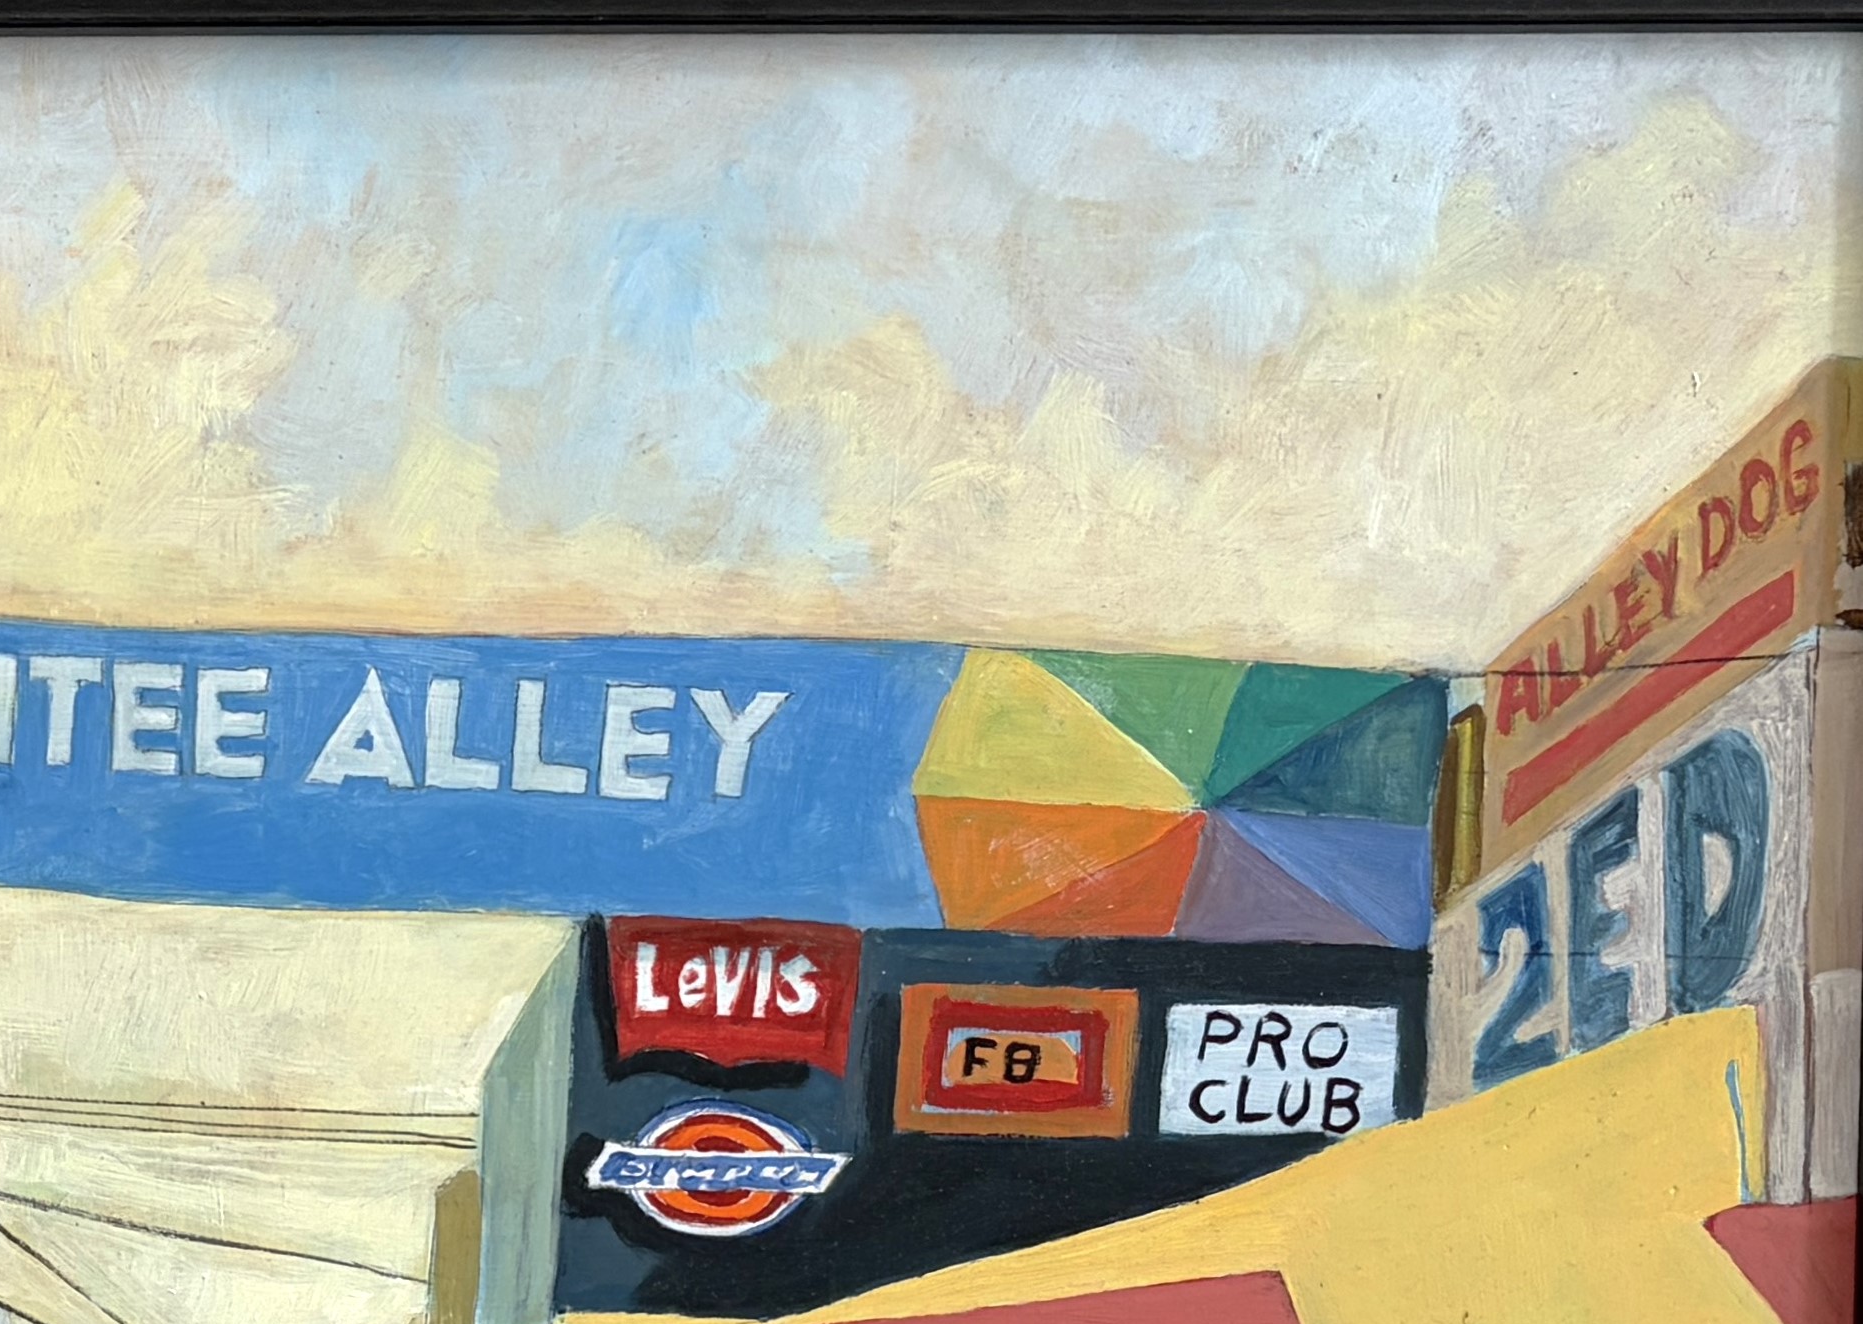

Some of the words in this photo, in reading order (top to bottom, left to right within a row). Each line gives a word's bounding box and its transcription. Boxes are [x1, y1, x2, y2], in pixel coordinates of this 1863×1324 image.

[1497, 529, 1678, 736] ALLEY
[1697, 419, 1819, 578] DOG
[304, 665, 796, 801] ALLEY
[1197, 1009, 1349, 1071] PRO
[1189, 1075, 1363, 1134] CLUB
